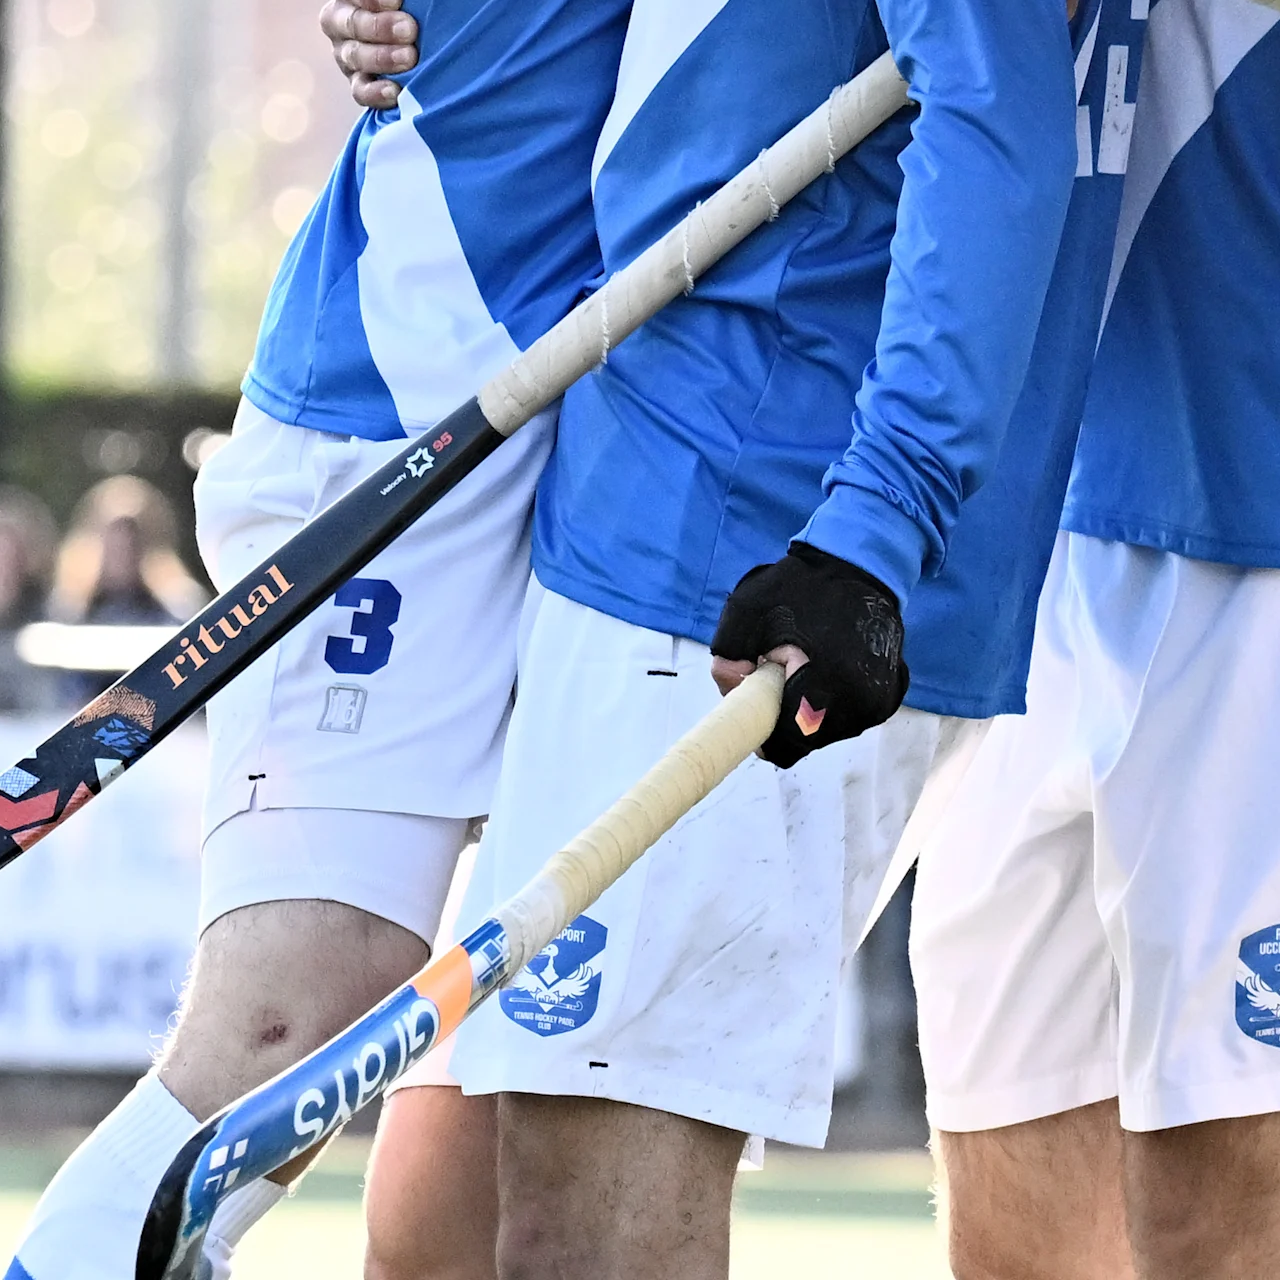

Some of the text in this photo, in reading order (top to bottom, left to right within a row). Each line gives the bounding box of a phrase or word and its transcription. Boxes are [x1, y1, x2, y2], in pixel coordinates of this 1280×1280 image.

[432, 431, 454, 453] 95
[160, 563, 295, 691] ritual
[323, 576, 403, 676] 3
[537, 1022, 552, 1030] CLUB
